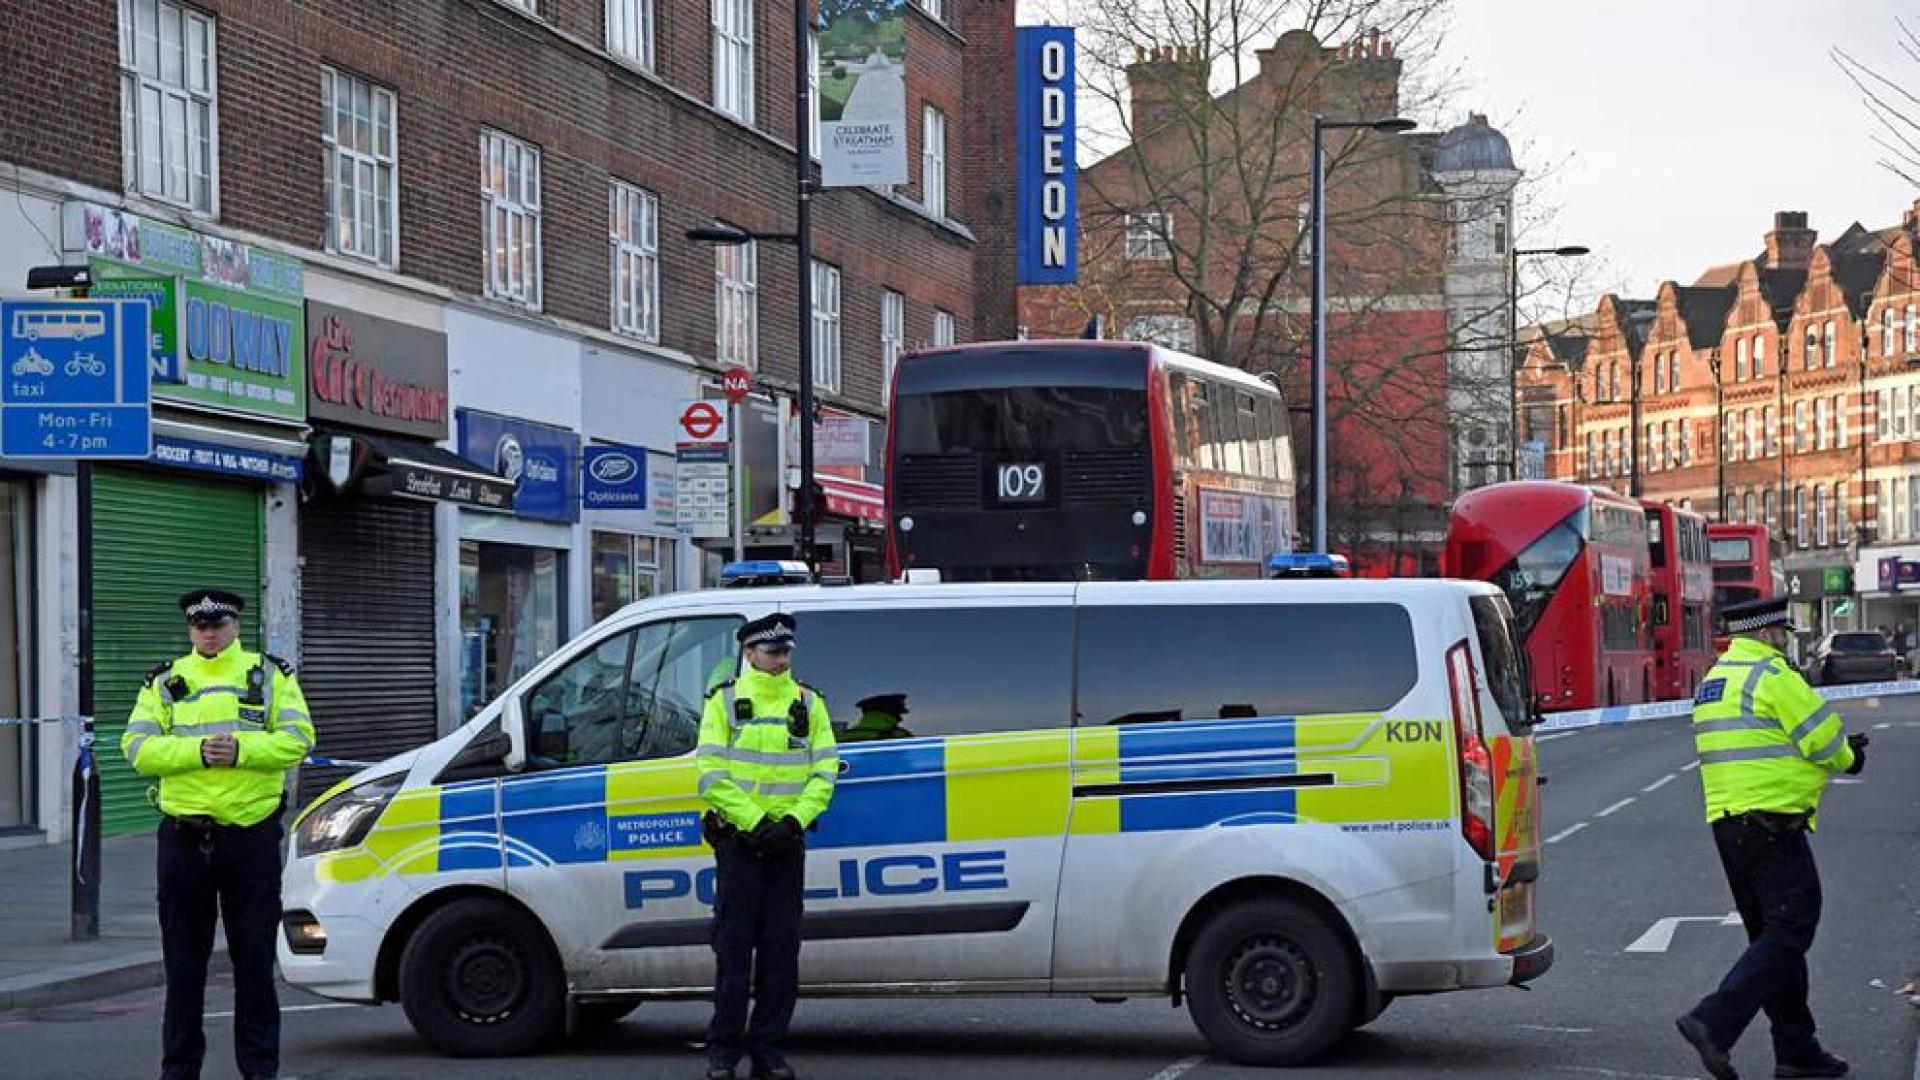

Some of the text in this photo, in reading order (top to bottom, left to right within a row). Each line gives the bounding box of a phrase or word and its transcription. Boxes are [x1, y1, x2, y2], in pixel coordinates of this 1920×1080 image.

[835, 124, 890, 135] CELEBRATE
[834, 135, 895, 147] STREATHAM
[1042, 40, 1067, 267] ODEON
[12, 380, 45, 397] taxi
[724, 377, 748, 390] NA
[156, 443, 190, 463] GROCERY
[998, 464, 1043, 497] 109
[588, 490, 640, 507] Opticians
[1386, 720, 1442, 743] KDN
[617, 817, 695, 831] METROPOLITAN
[1341, 821, 1450, 834] www.met.police.uk
[628, 831, 684, 845] POLICE
[623, 850, 1009, 910] PICE
